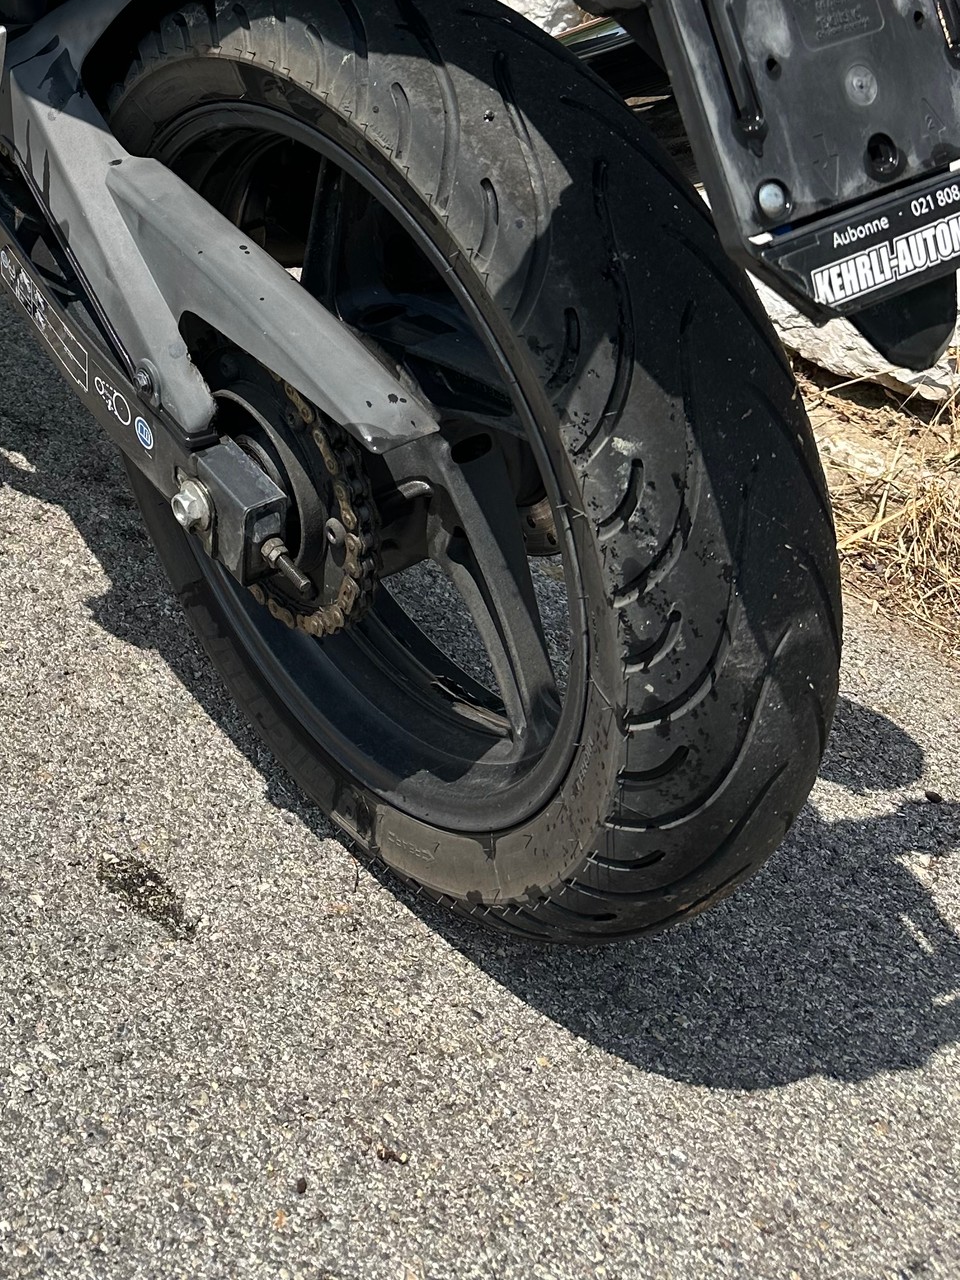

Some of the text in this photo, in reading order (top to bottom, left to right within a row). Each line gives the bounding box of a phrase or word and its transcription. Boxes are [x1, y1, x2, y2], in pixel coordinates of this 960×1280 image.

[832, 184, 960, 249] Aubonne 021 808
